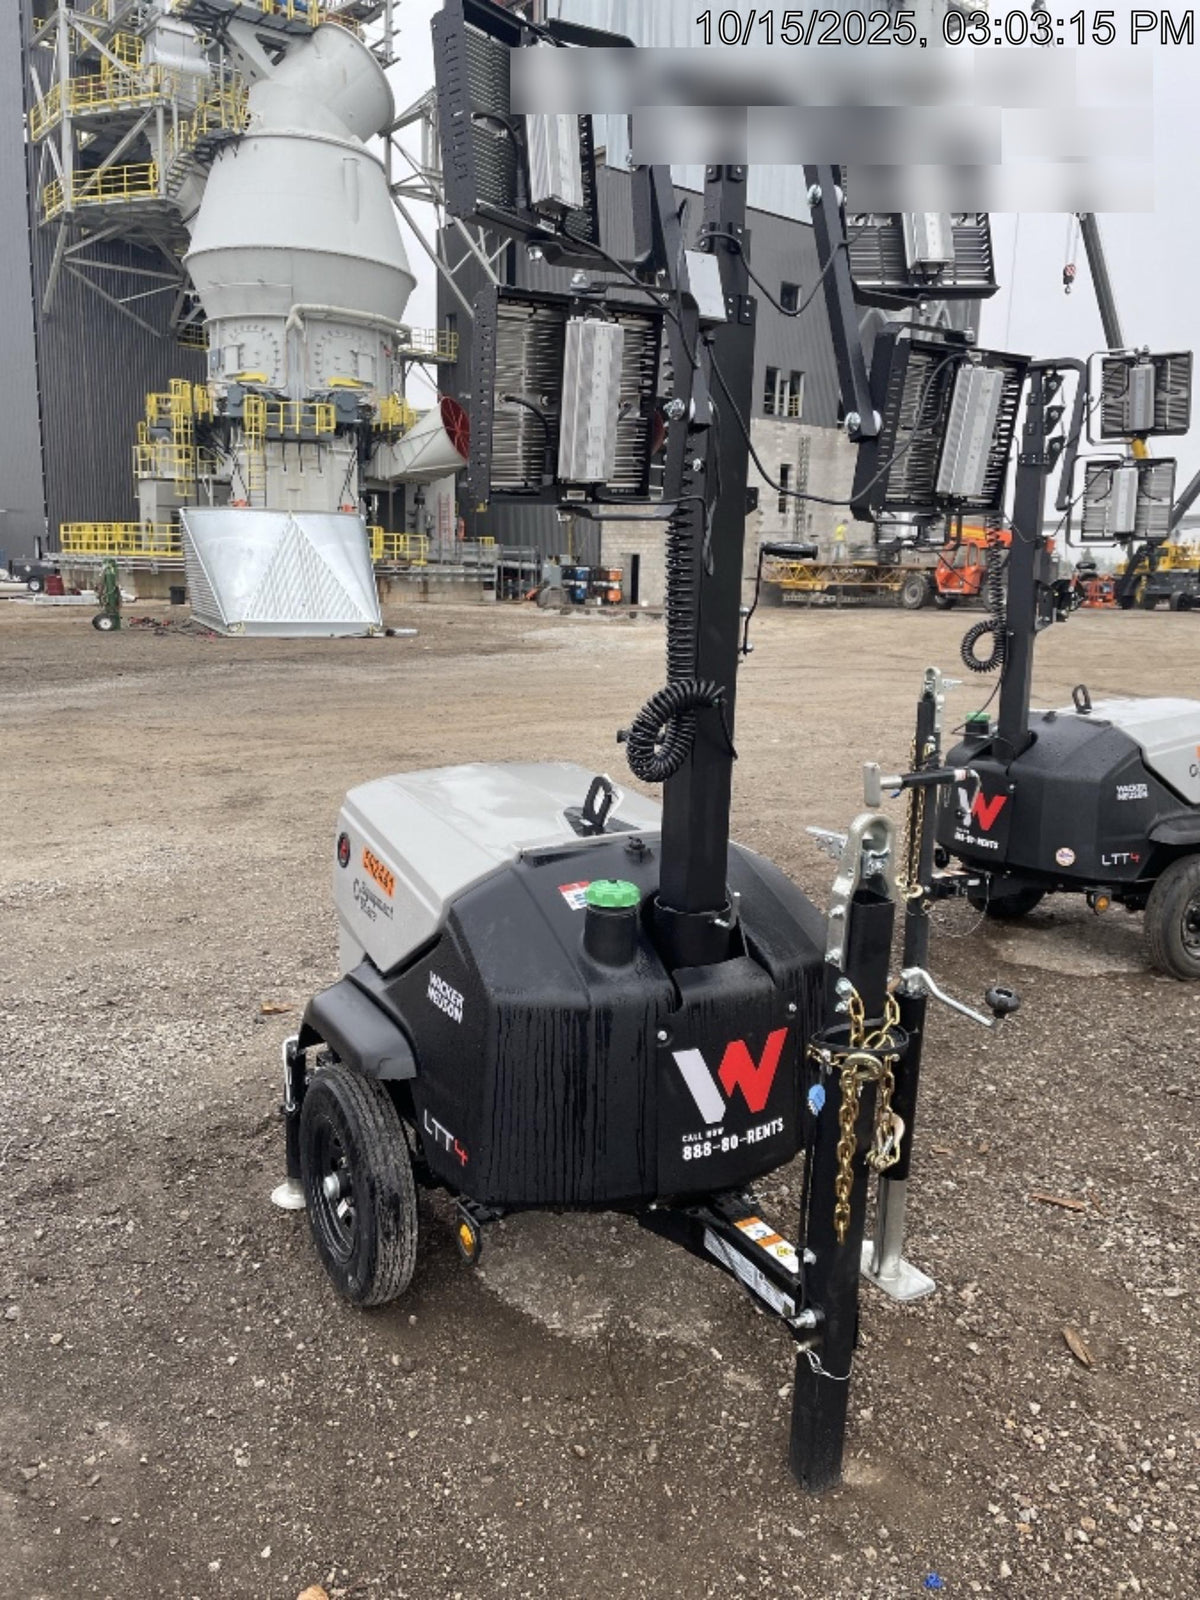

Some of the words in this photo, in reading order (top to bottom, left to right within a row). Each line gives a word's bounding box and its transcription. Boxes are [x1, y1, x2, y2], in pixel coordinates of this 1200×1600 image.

[1101, 852, 1140, 866] LTT4
[427, 985, 463, 1024] NEUSON
[429, 970, 464, 1009] WACKER
[424, 1108, 468, 1167] LTT4
[682, 1132, 703, 1142] CALL
[682, 1117, 785, 1161] 888-80-RENTS
